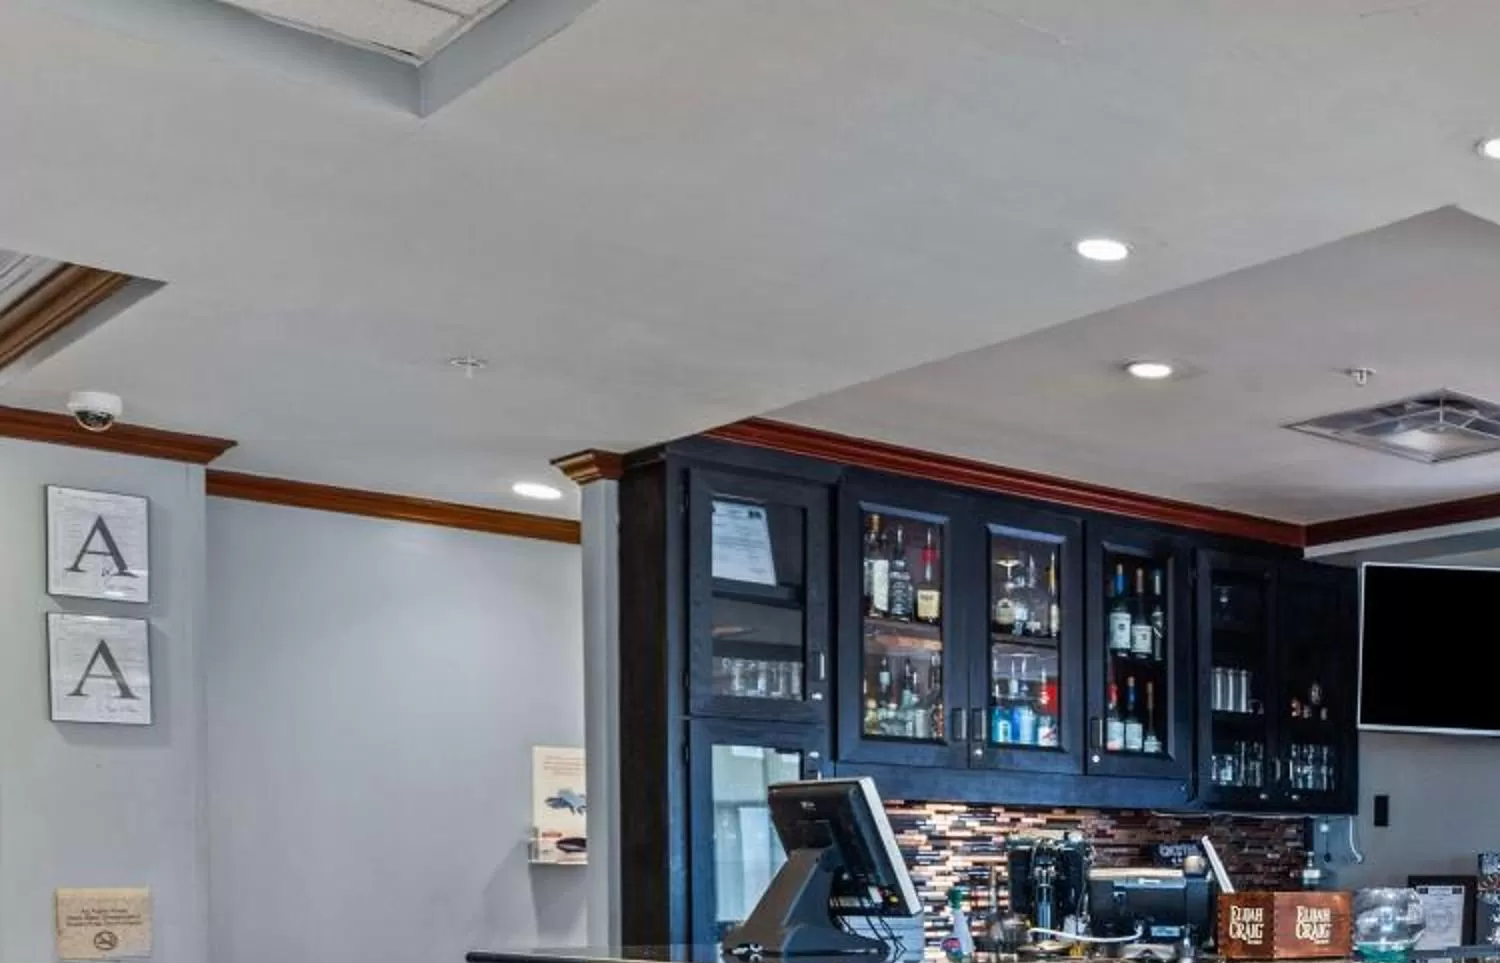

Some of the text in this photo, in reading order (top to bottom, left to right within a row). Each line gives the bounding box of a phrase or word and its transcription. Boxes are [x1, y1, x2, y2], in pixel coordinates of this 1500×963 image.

[64, 514, 140, 579] A
[66, 639, 142, 700] A
[1230, 905, 1264, 921] ELIJAH
[1296, 905, 1331, 921] ELIJAH
[1229, 923, 1264, 941] CRAIG
[1295, 923, 1332, 941] CRAIG
